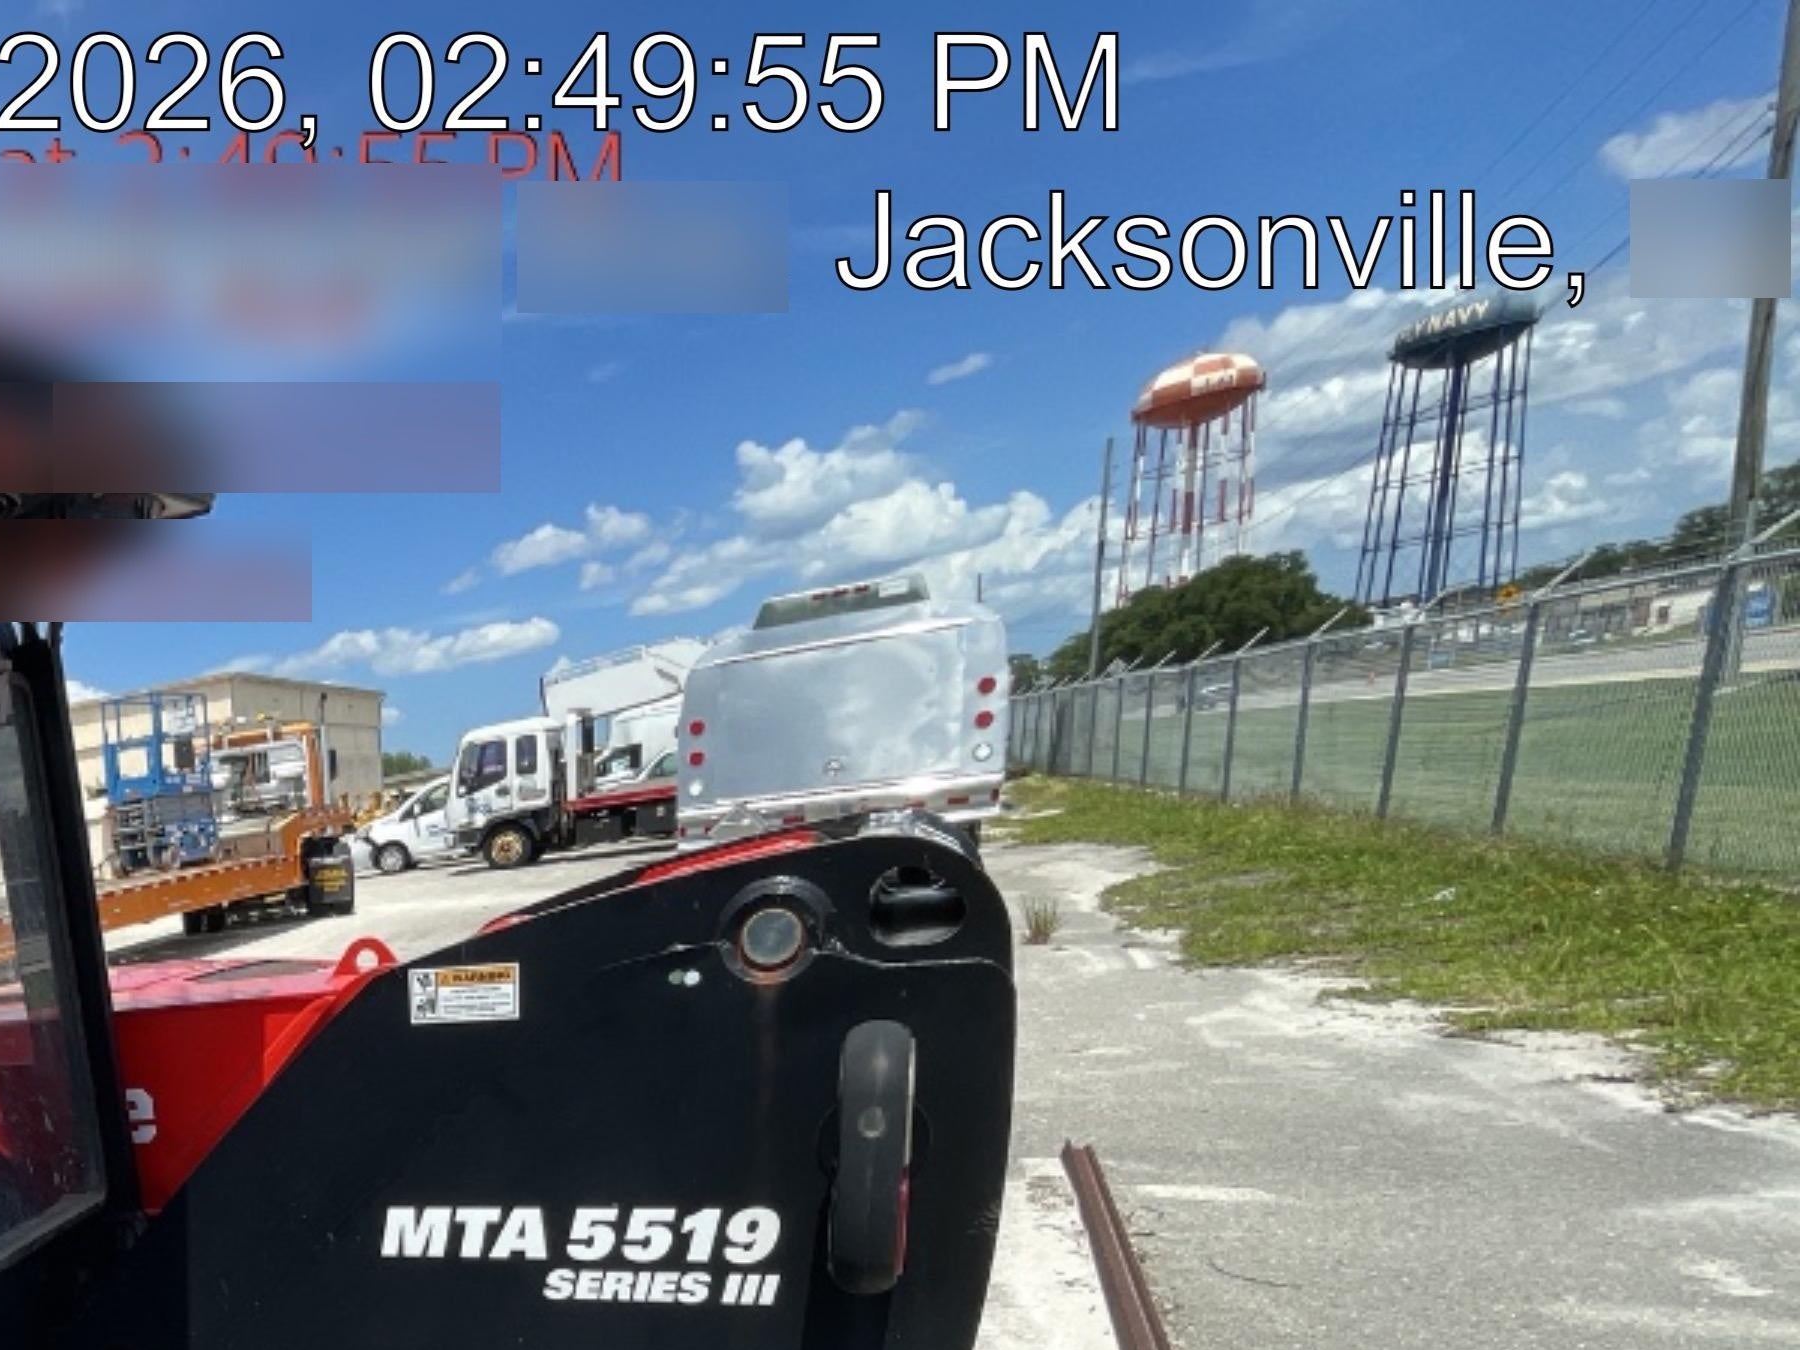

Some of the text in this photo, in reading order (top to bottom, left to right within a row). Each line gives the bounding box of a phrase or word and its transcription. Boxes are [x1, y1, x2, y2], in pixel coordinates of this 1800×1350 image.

[380, 1204, 782, 1265] MTA 5519
[542, 1267, 782, 1306] SERIES III
